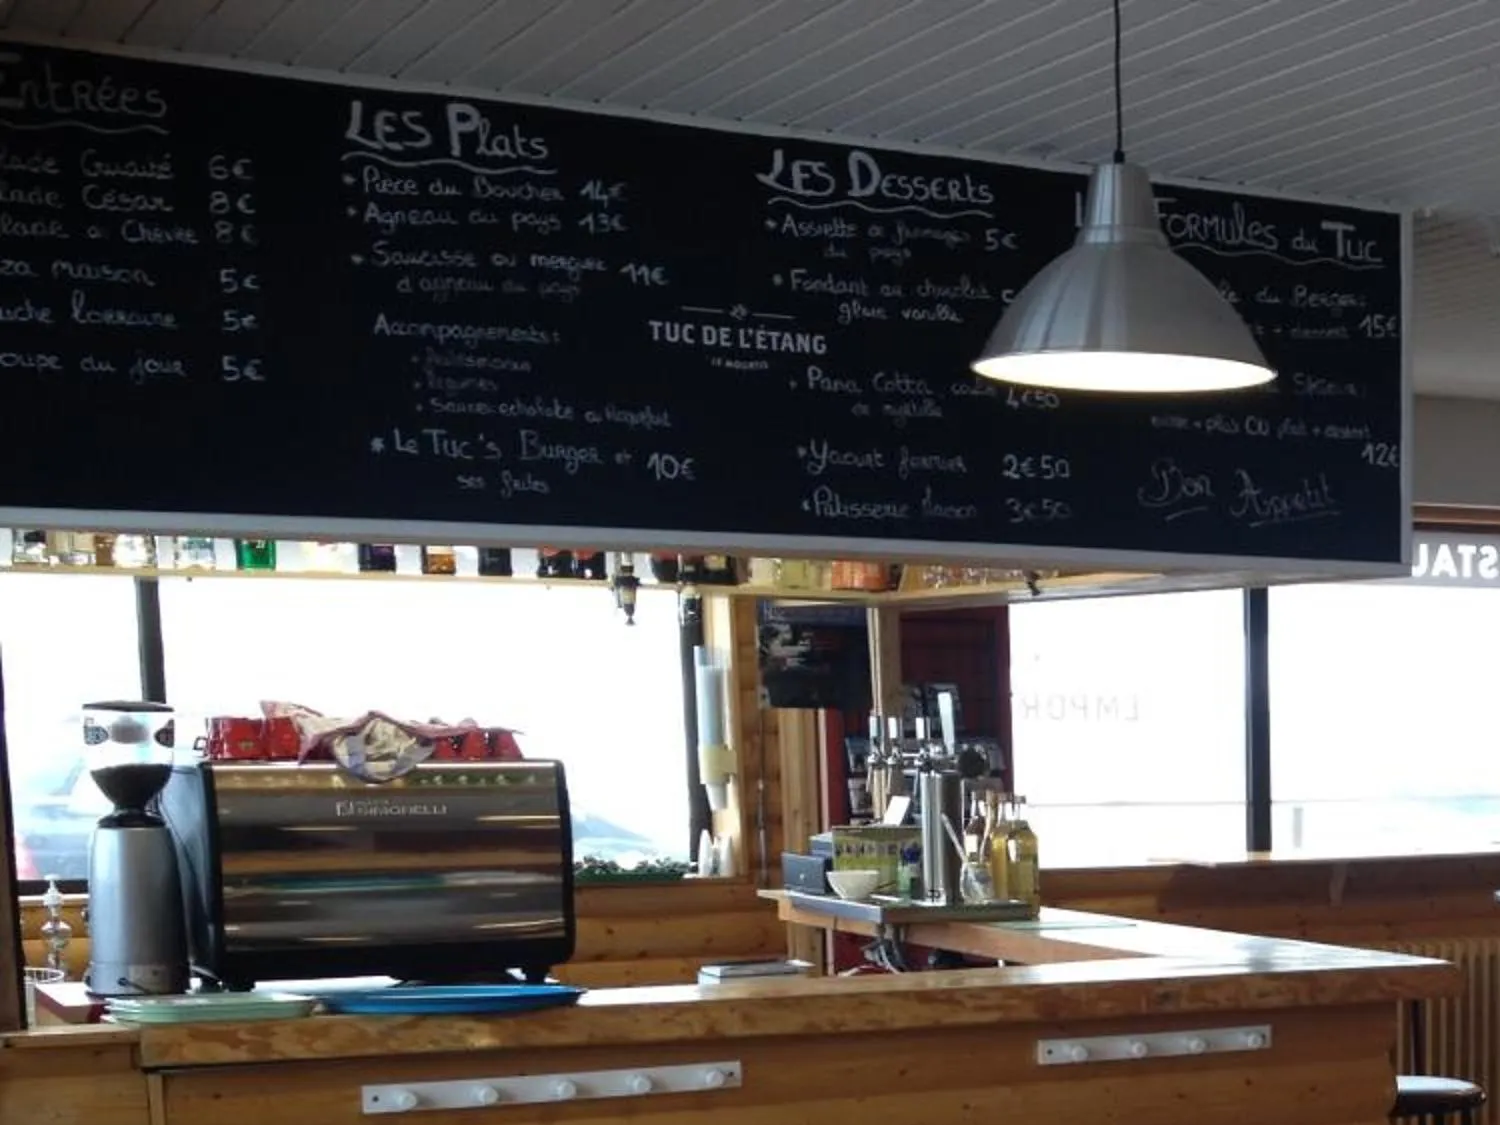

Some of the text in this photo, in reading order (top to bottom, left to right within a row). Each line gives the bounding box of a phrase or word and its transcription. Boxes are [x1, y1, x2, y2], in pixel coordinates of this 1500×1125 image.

[446, 102, 550, 159] Plats
[648, 319, 697, 346] TUC
[702, 324, 733, 348] DE
[646, 451, 698, 482] 10€
